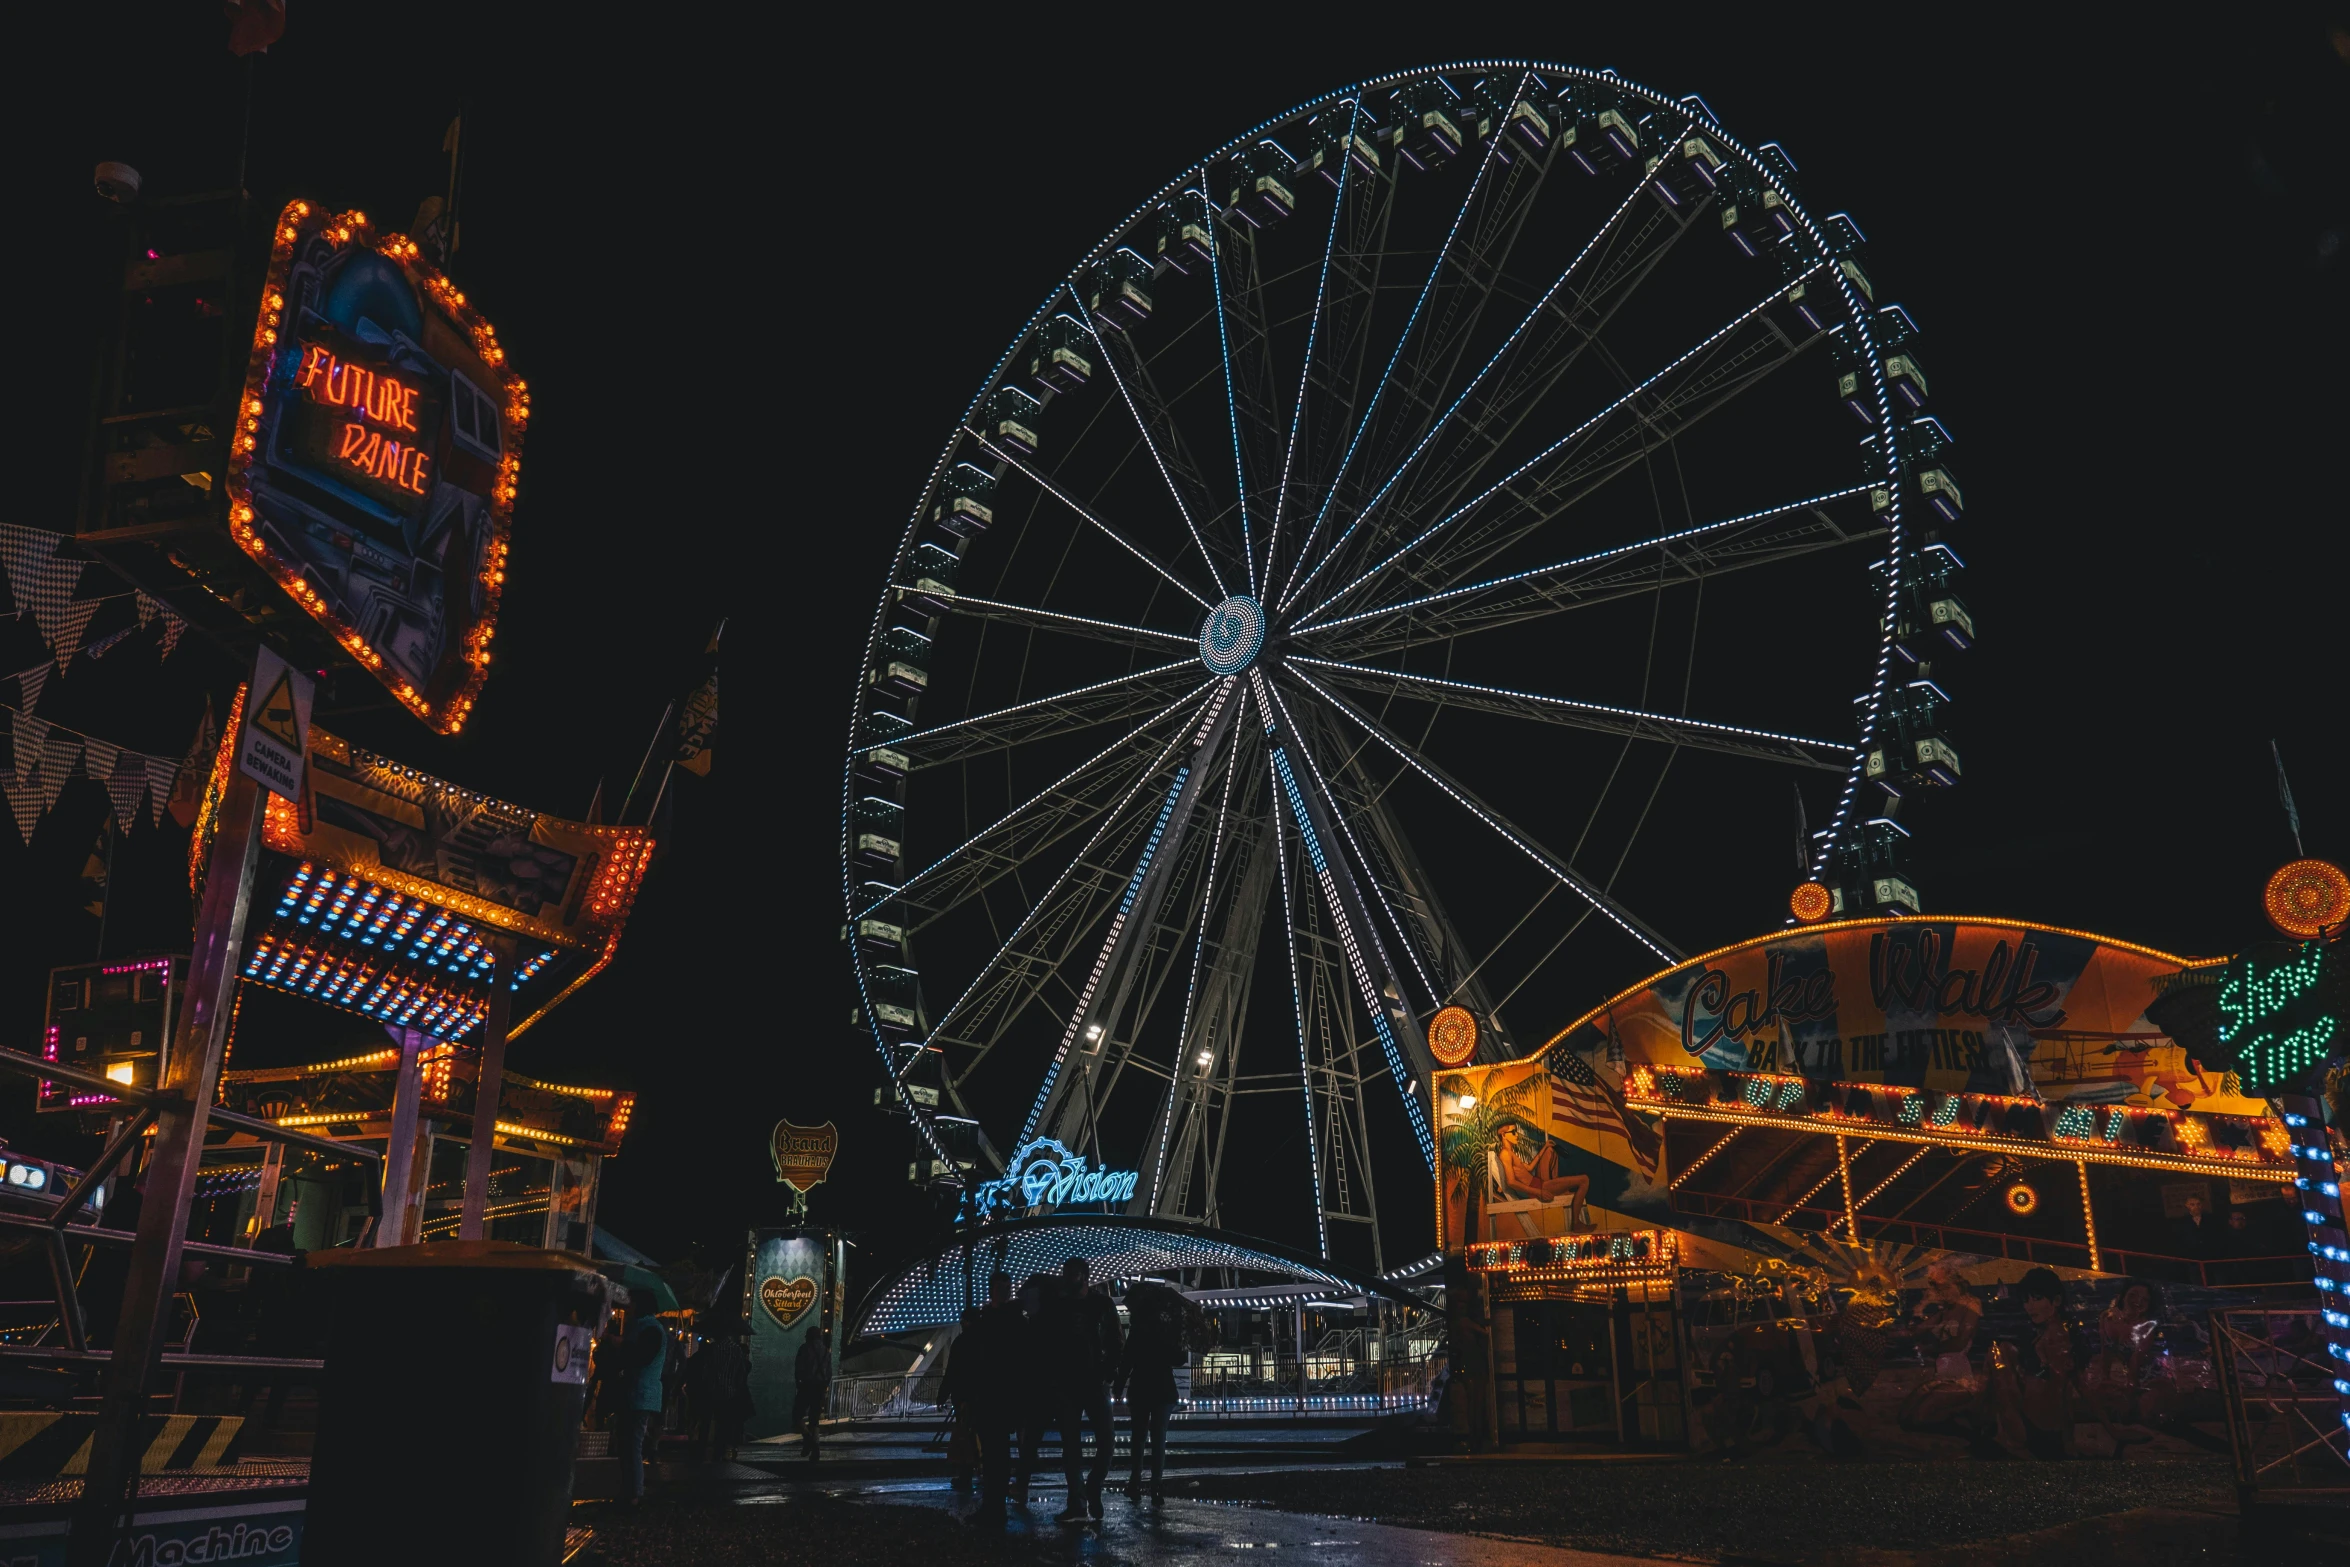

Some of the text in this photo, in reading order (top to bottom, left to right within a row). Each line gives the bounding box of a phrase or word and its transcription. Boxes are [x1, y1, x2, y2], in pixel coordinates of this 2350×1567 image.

[302, 345, 419, 432] FUTURE
[339, 423, 430, 495] DANCE
[246, 752, 295, 791] BEWAKING
[254, 740, 292, 772] CAMERA
[1681, 927, 2068, 1058] Cake Walk
[2217, 946, 2323, 1042] Show
[1746, 1027, 1991, 1075] BAK TO THE FIFTIES!
[2237, 1015, 2336, 1090] Time
[780, 1128, 832, 1153] Brand
[780, 1153, 829, 1167] BRAUHAUS
[763, 1288, 813, 1300] Oktoberfest
[773, 1298, 803, 1308] Sittard
[107, 1522, 294, 1567] Machine
